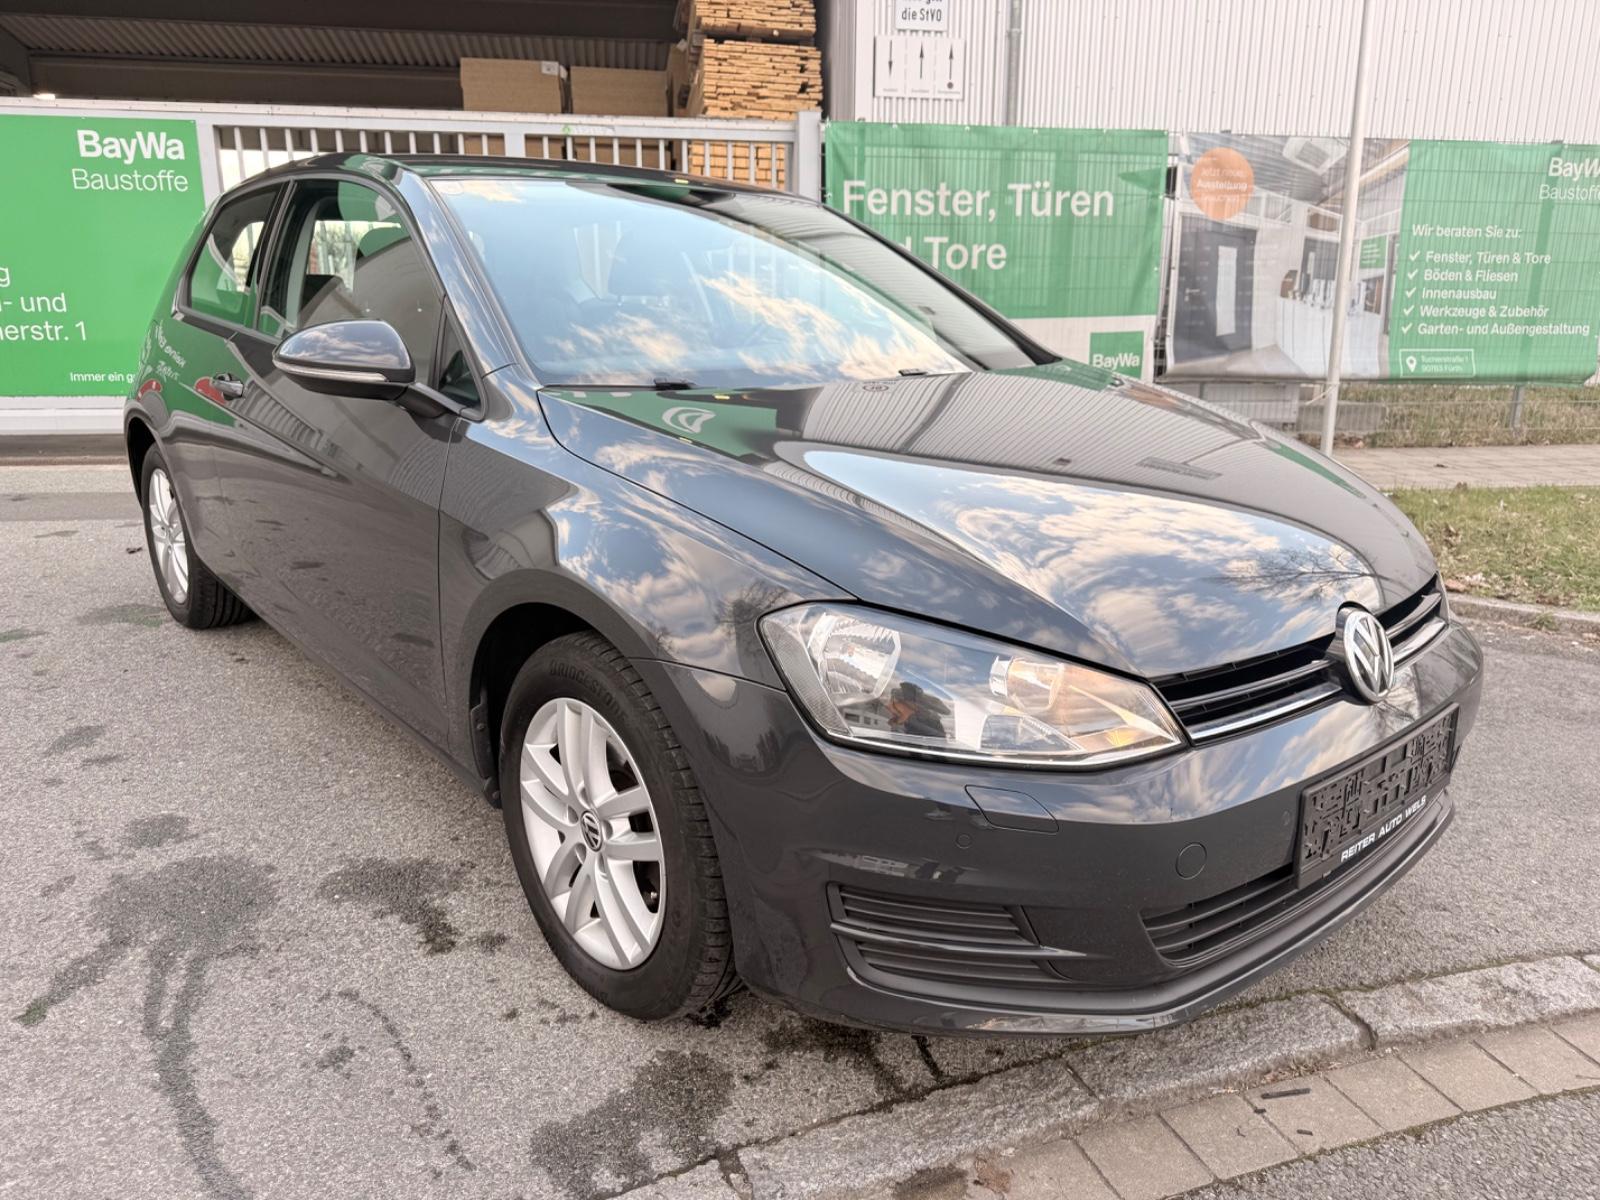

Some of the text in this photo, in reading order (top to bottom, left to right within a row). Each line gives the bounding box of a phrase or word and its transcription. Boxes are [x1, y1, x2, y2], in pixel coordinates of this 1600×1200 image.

[901, 8, 942, 22] die StVO
[77, 129, 185, 165] BayWa
[71, 168, 188, 192] Baustoffe
[1539, 184, 1600, 200] Baustoff
[843, 180, 1115, 222] Fenster, Türen
[1412, 224, 1523, 239] Wir beraten Sie zu:
[923, 236, 1007, 270] Tore
[1425, 251, 1552, 265] Fenster, Türen & Tore
[1423, 268, 1519, 282] Böden & Fliesen
[1421, 287, 1497, 300] Innenausbau
[20, 292, 67, 313] und
[1419, 305, 1549, 319] Werkzeuge & Zubehör
[75, 320, 87, 341] 1
[1417, 323, 1591, 337] Garten- und Außengestaltung
[1092, 352, 1141, 371] BayWa
[70, 372, 106, 382] Immer
[108, 371, 124, 382] ein
[1341, 832, 1376, 863] REITER
[1378, 813, 1402, 839] AUTO
